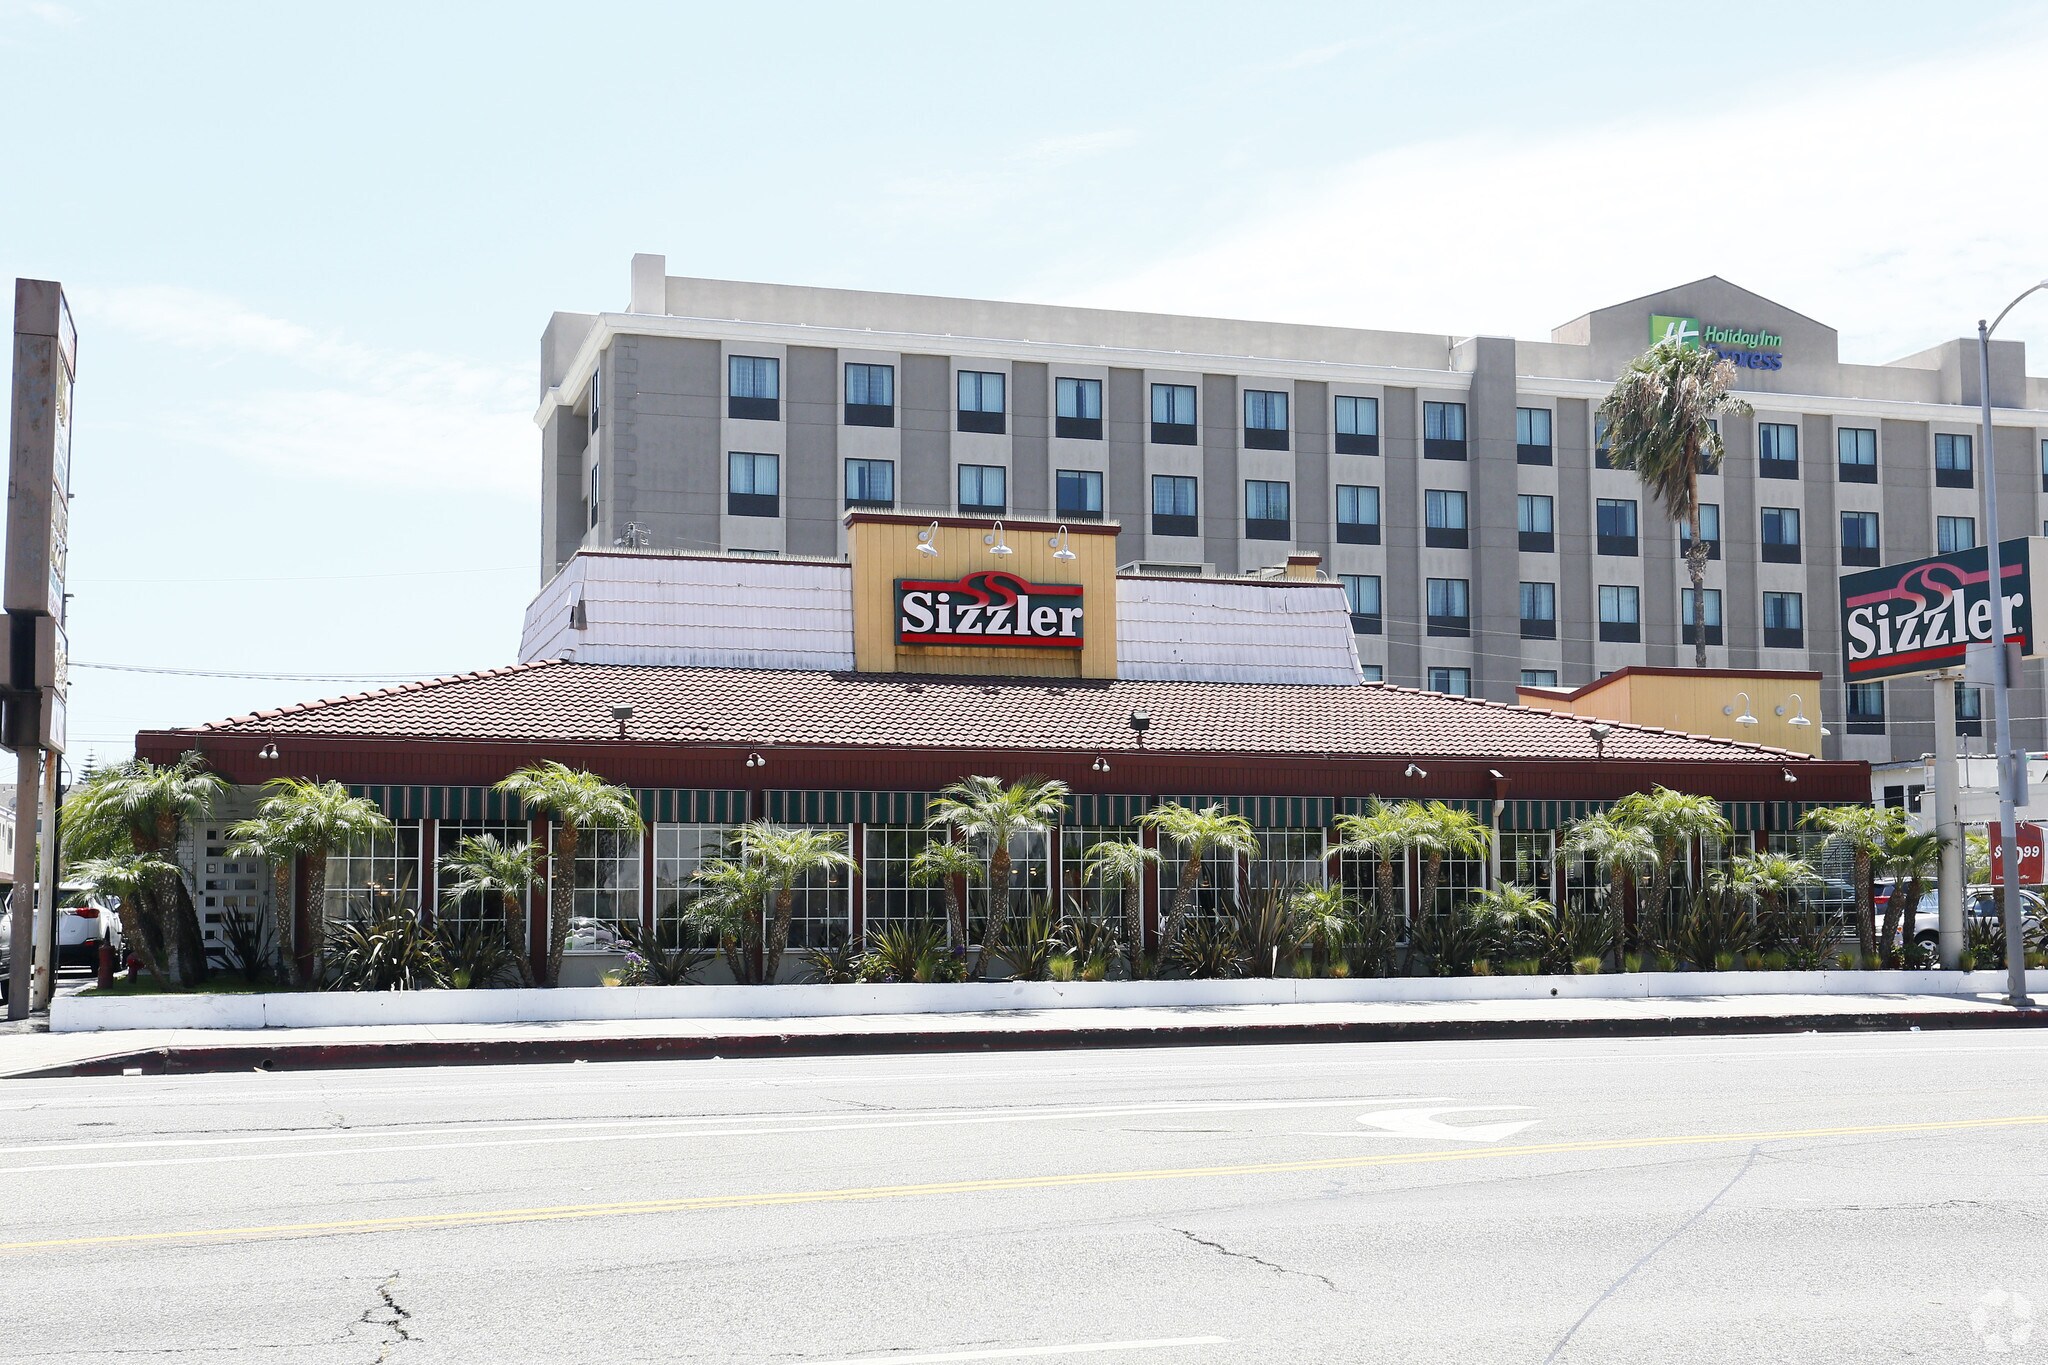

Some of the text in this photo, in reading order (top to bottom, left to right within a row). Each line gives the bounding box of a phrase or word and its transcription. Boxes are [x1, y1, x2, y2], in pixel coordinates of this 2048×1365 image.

[1704, 325, 1782, 349] Holiday Inn
[902, 591, 1083, 636] Sizzler
[1847, 588, 2024, 661] Sizzler
